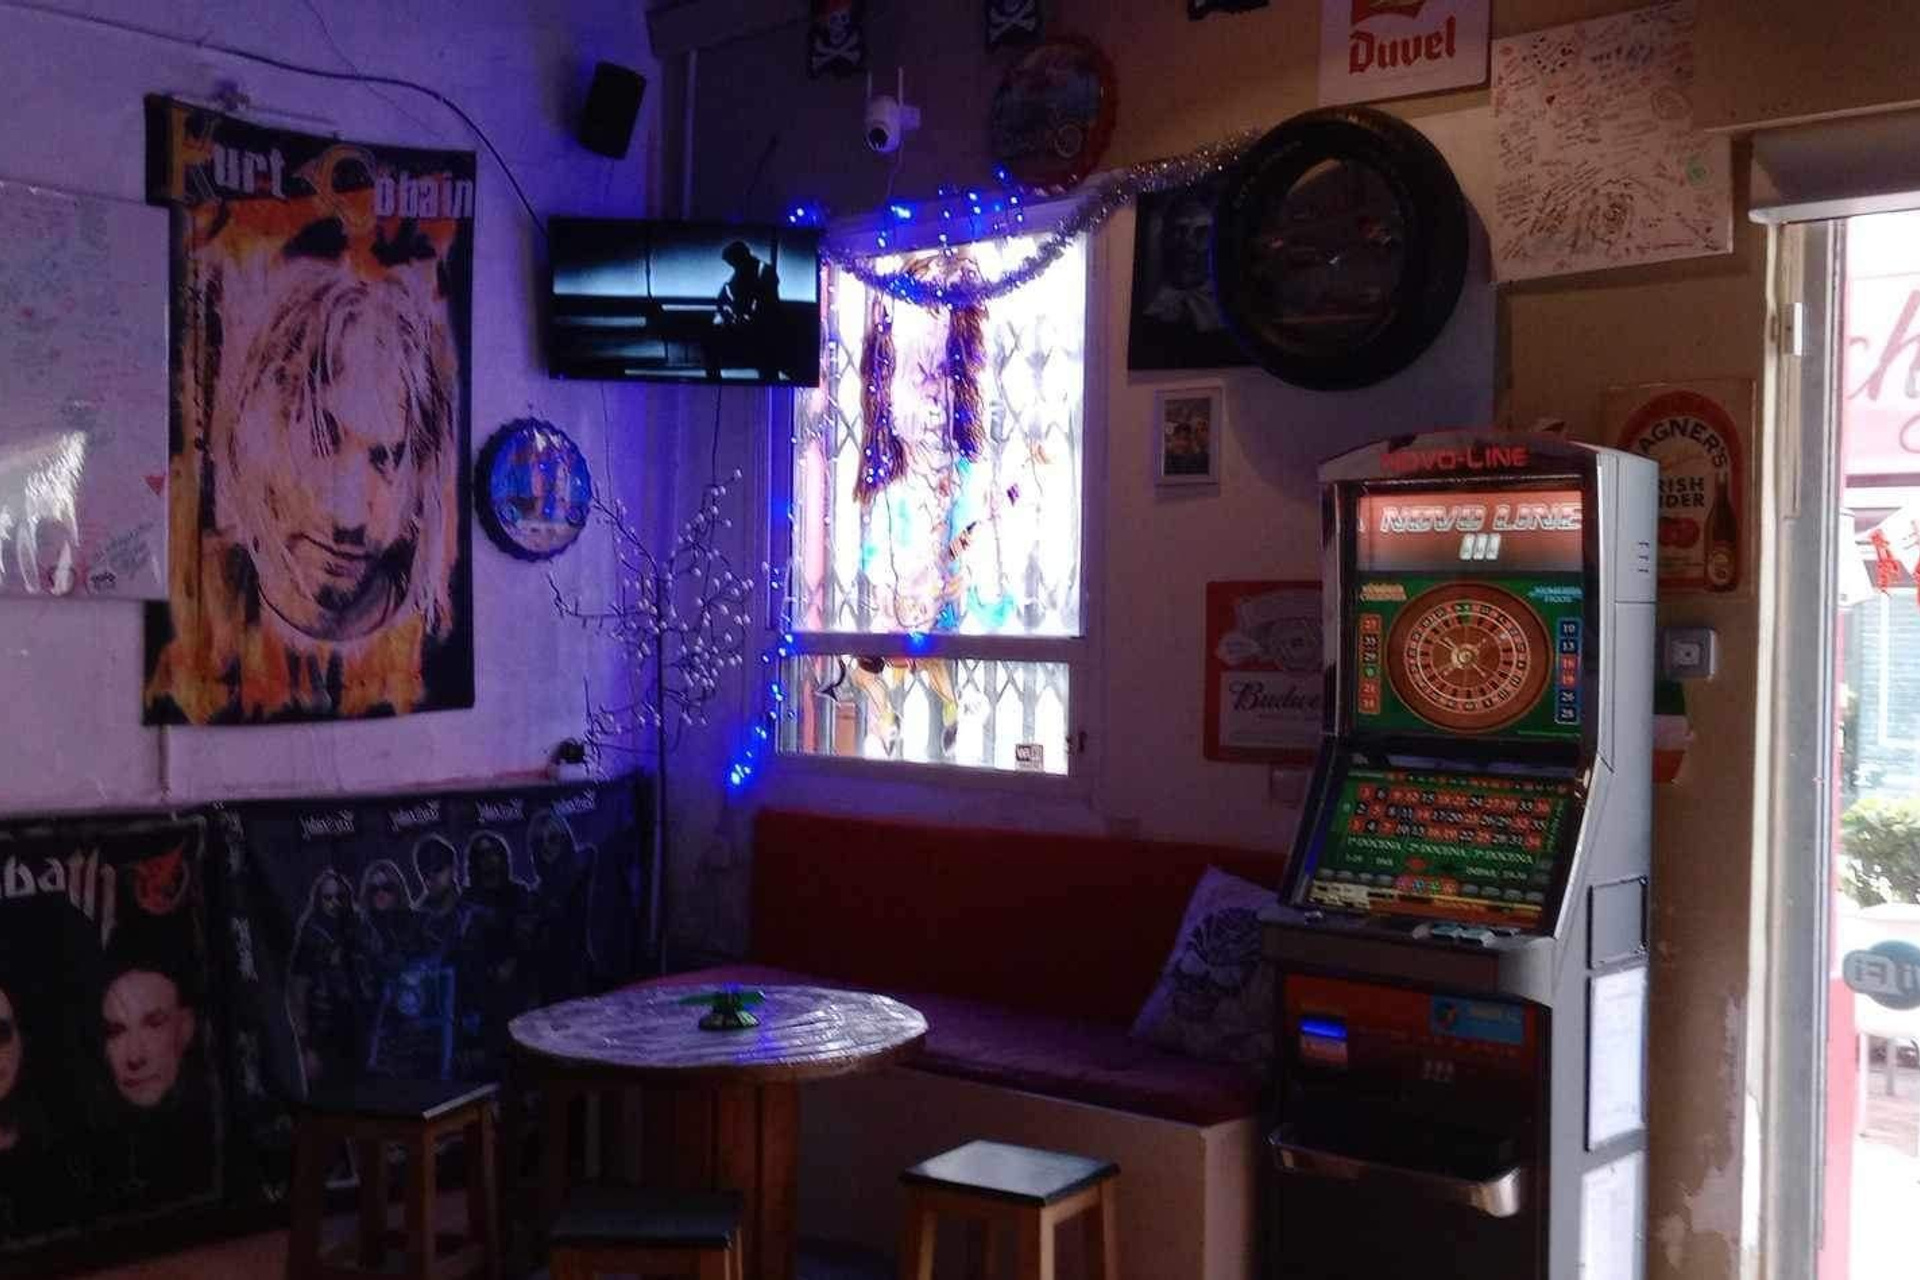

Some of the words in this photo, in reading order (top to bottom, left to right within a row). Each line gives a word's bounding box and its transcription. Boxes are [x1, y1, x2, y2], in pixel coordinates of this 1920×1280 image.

[1349, 15, 1456, 74] Duvel
[1638, 417, 1728, 468] AGNER'S
[1659, 476, 1704, 492] RISH
[1659, 493, 1704, 509] IDER
[1379, 505, 1485, 532] NOVO
[1492, 502, 1583, 531] LINE
[0, 848, 117, 948] bath
